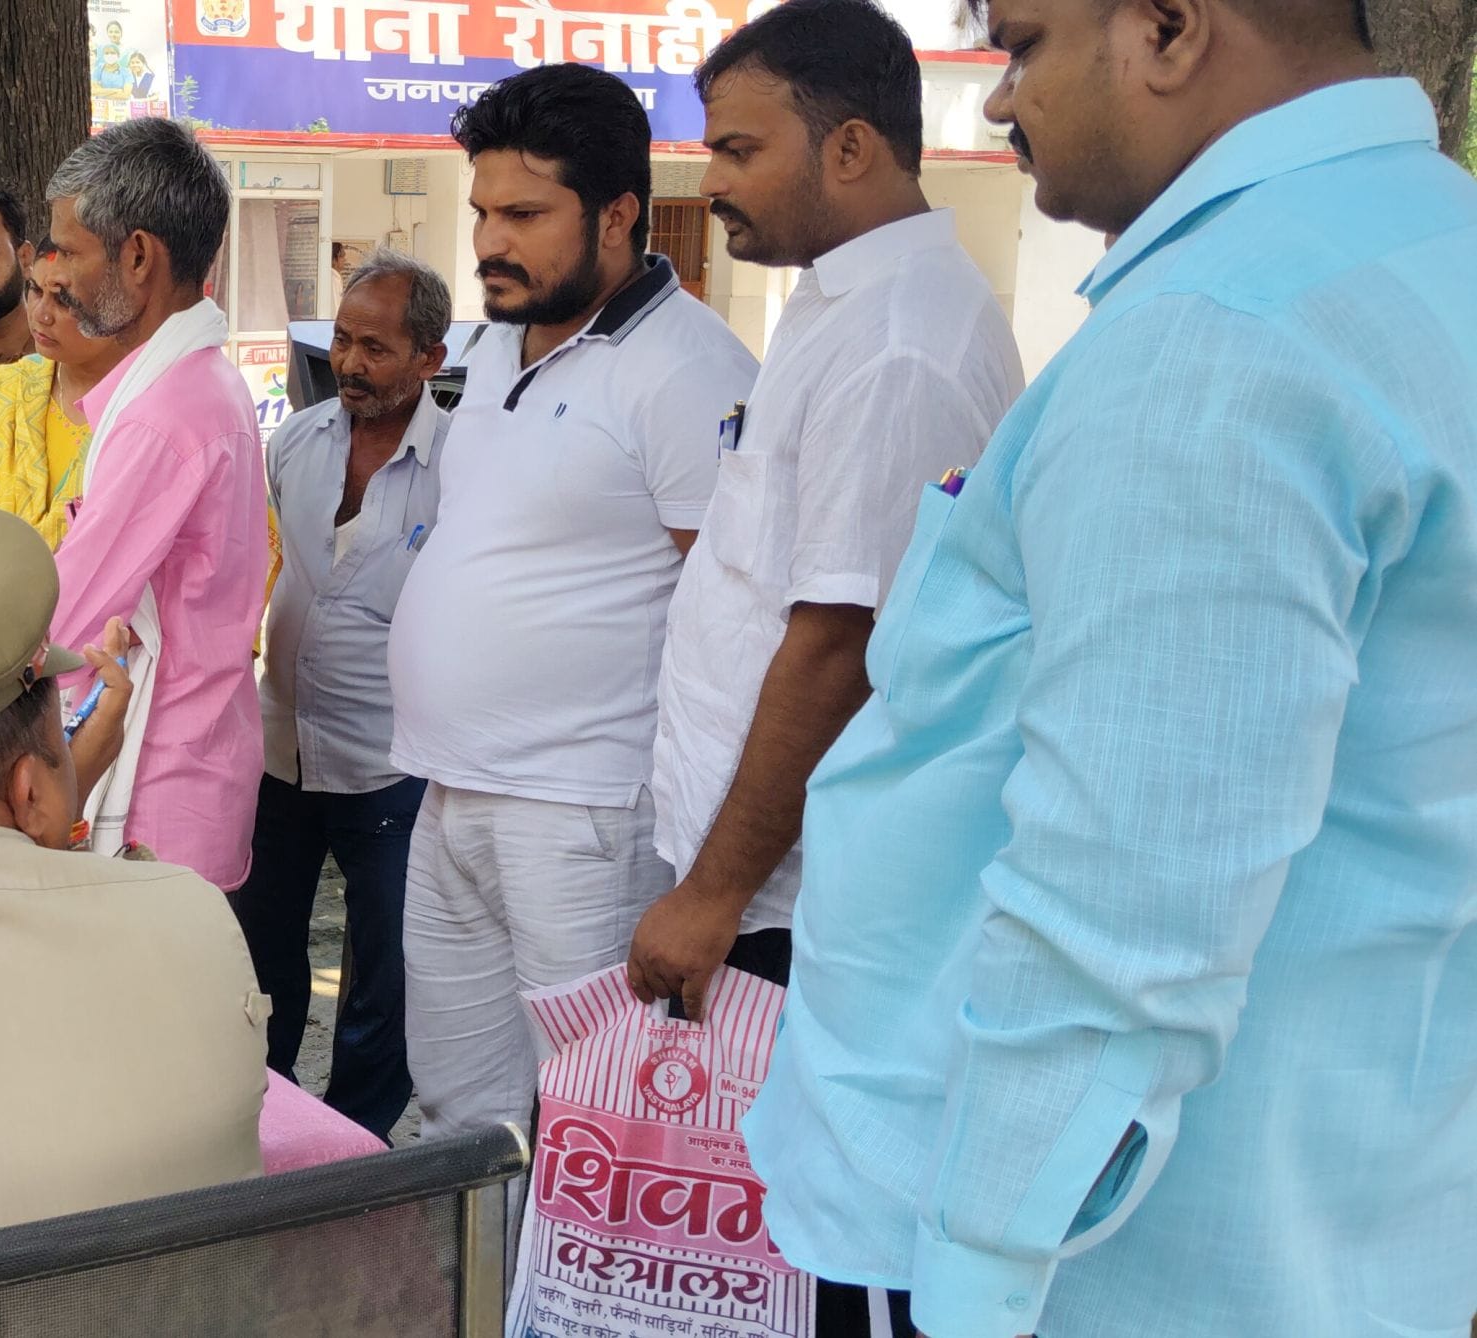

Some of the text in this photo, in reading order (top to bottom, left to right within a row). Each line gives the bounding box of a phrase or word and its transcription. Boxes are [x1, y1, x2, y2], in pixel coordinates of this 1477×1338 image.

[275, 0, 470, 66] थाना
[253, 349, 278, 363] UTTAR
[256, 399, 290, 425] 11
[650, 1049, 699, 1071] SHIVAM
[641, 1082, 702, 1113] VASTRALAYA
[710, 1155, 726, 1167] का
[557, 1231, 772, 1311] वस्त्रालय
